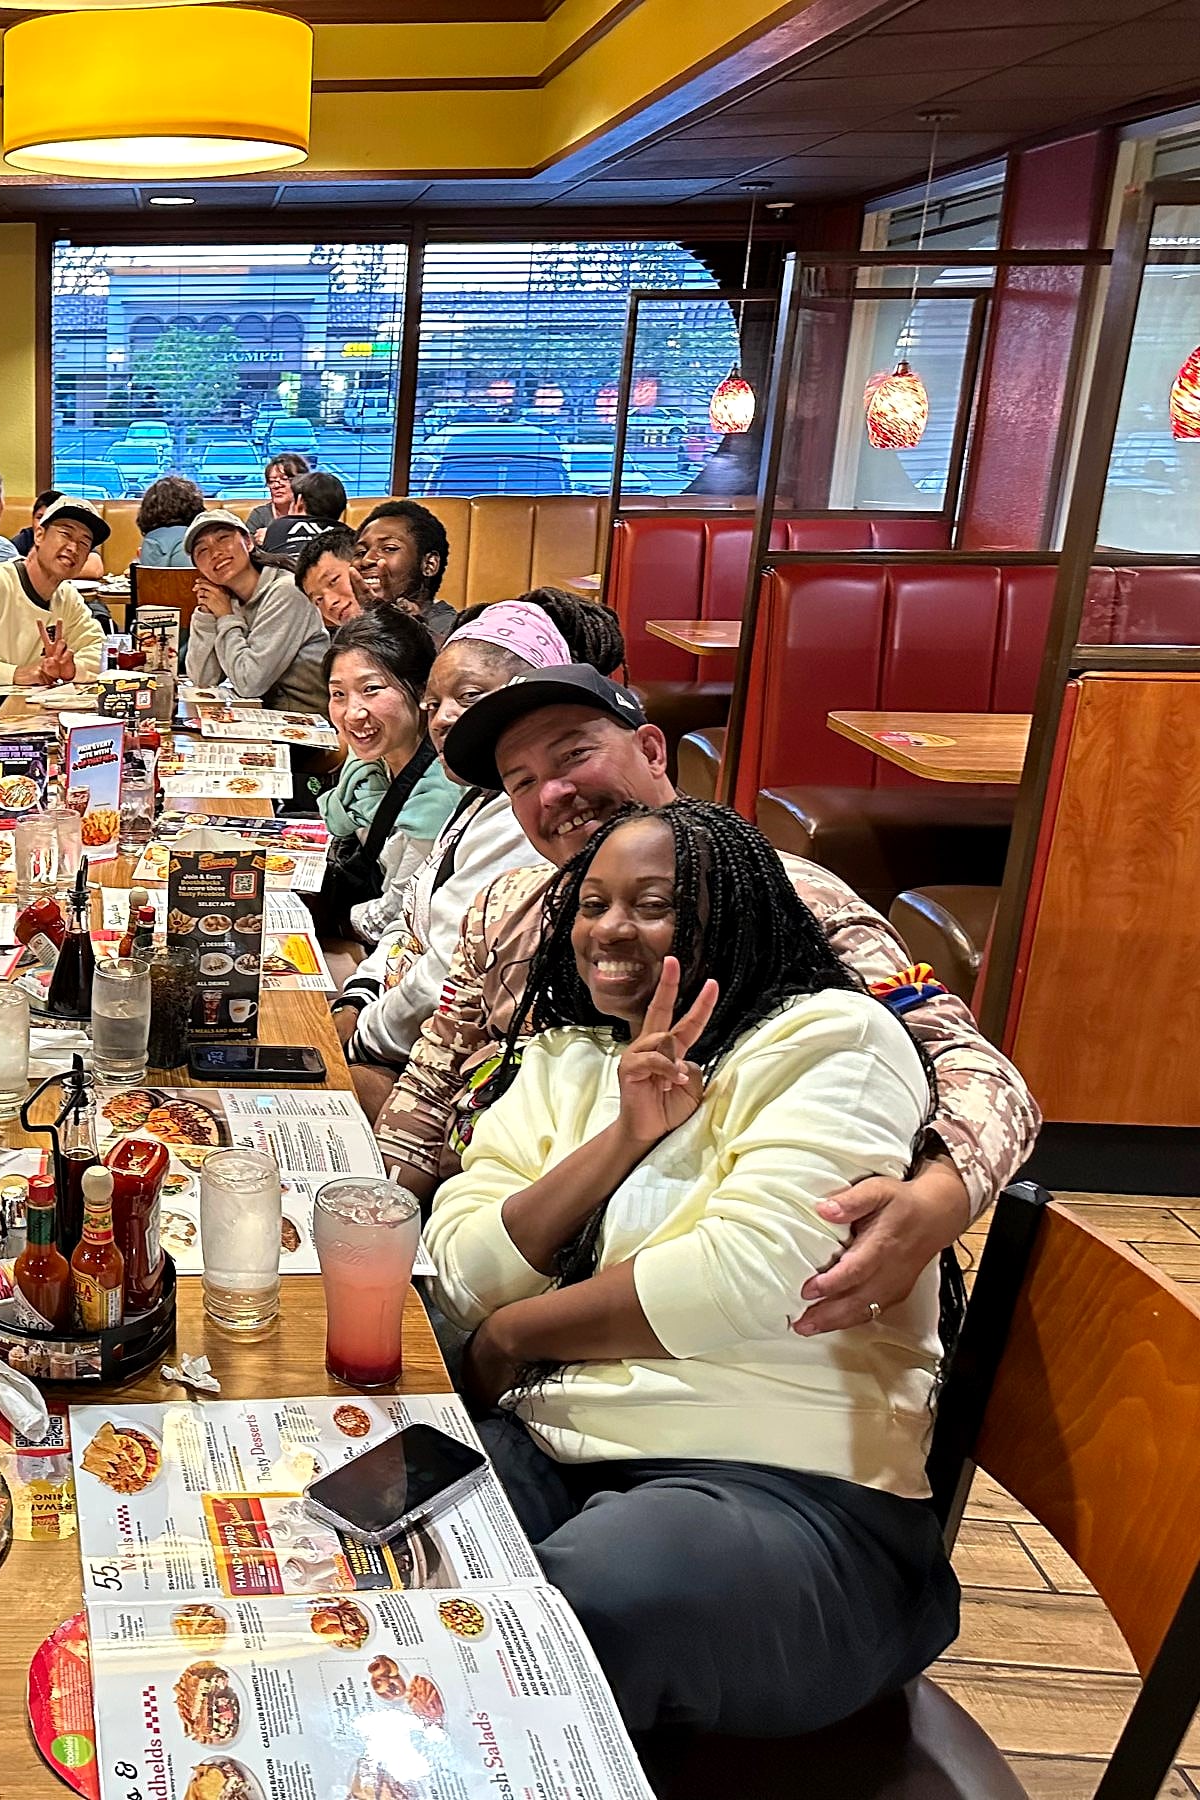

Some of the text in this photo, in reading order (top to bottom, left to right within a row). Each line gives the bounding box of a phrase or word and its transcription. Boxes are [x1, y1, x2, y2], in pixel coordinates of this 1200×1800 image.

[224, 350, 284, 361] POMPEI
[244, 1414, 272, 1483] Tasty Desserts
[224, 1525, 247, 1589] HAND-DIPPED
[455, 1537, 468, 1554] SUNDAE
[349, 1549, 363, 1575] WANNA
[464, 1554, 478, 1579] BROWNIE
[390, 1623, 403, 1645] CHICKEN
[513, 1618, 527, 1639] ALASKA
[494, 1618, 531, 1696] ADD CRISPY FRIED CHICKEN
[500, 1611, 541, 1696] ADD GRILLED CHICKEN BREAST
[523, 1639, 544, 1680] WILD-CAUGHT
[540, 1681, 551, 1696] ADD
[251, 1675, 271, 1748] CALI CLUB SANDWICH
[472, 1712, 513, 1800] esh Salads
[115, 1761, 138, 1779] &
[144, 1739, 168, 1800] dhelds
[266, 1759, 276, 1785] BACON
[277, 1779, 286, 1800] WICH
